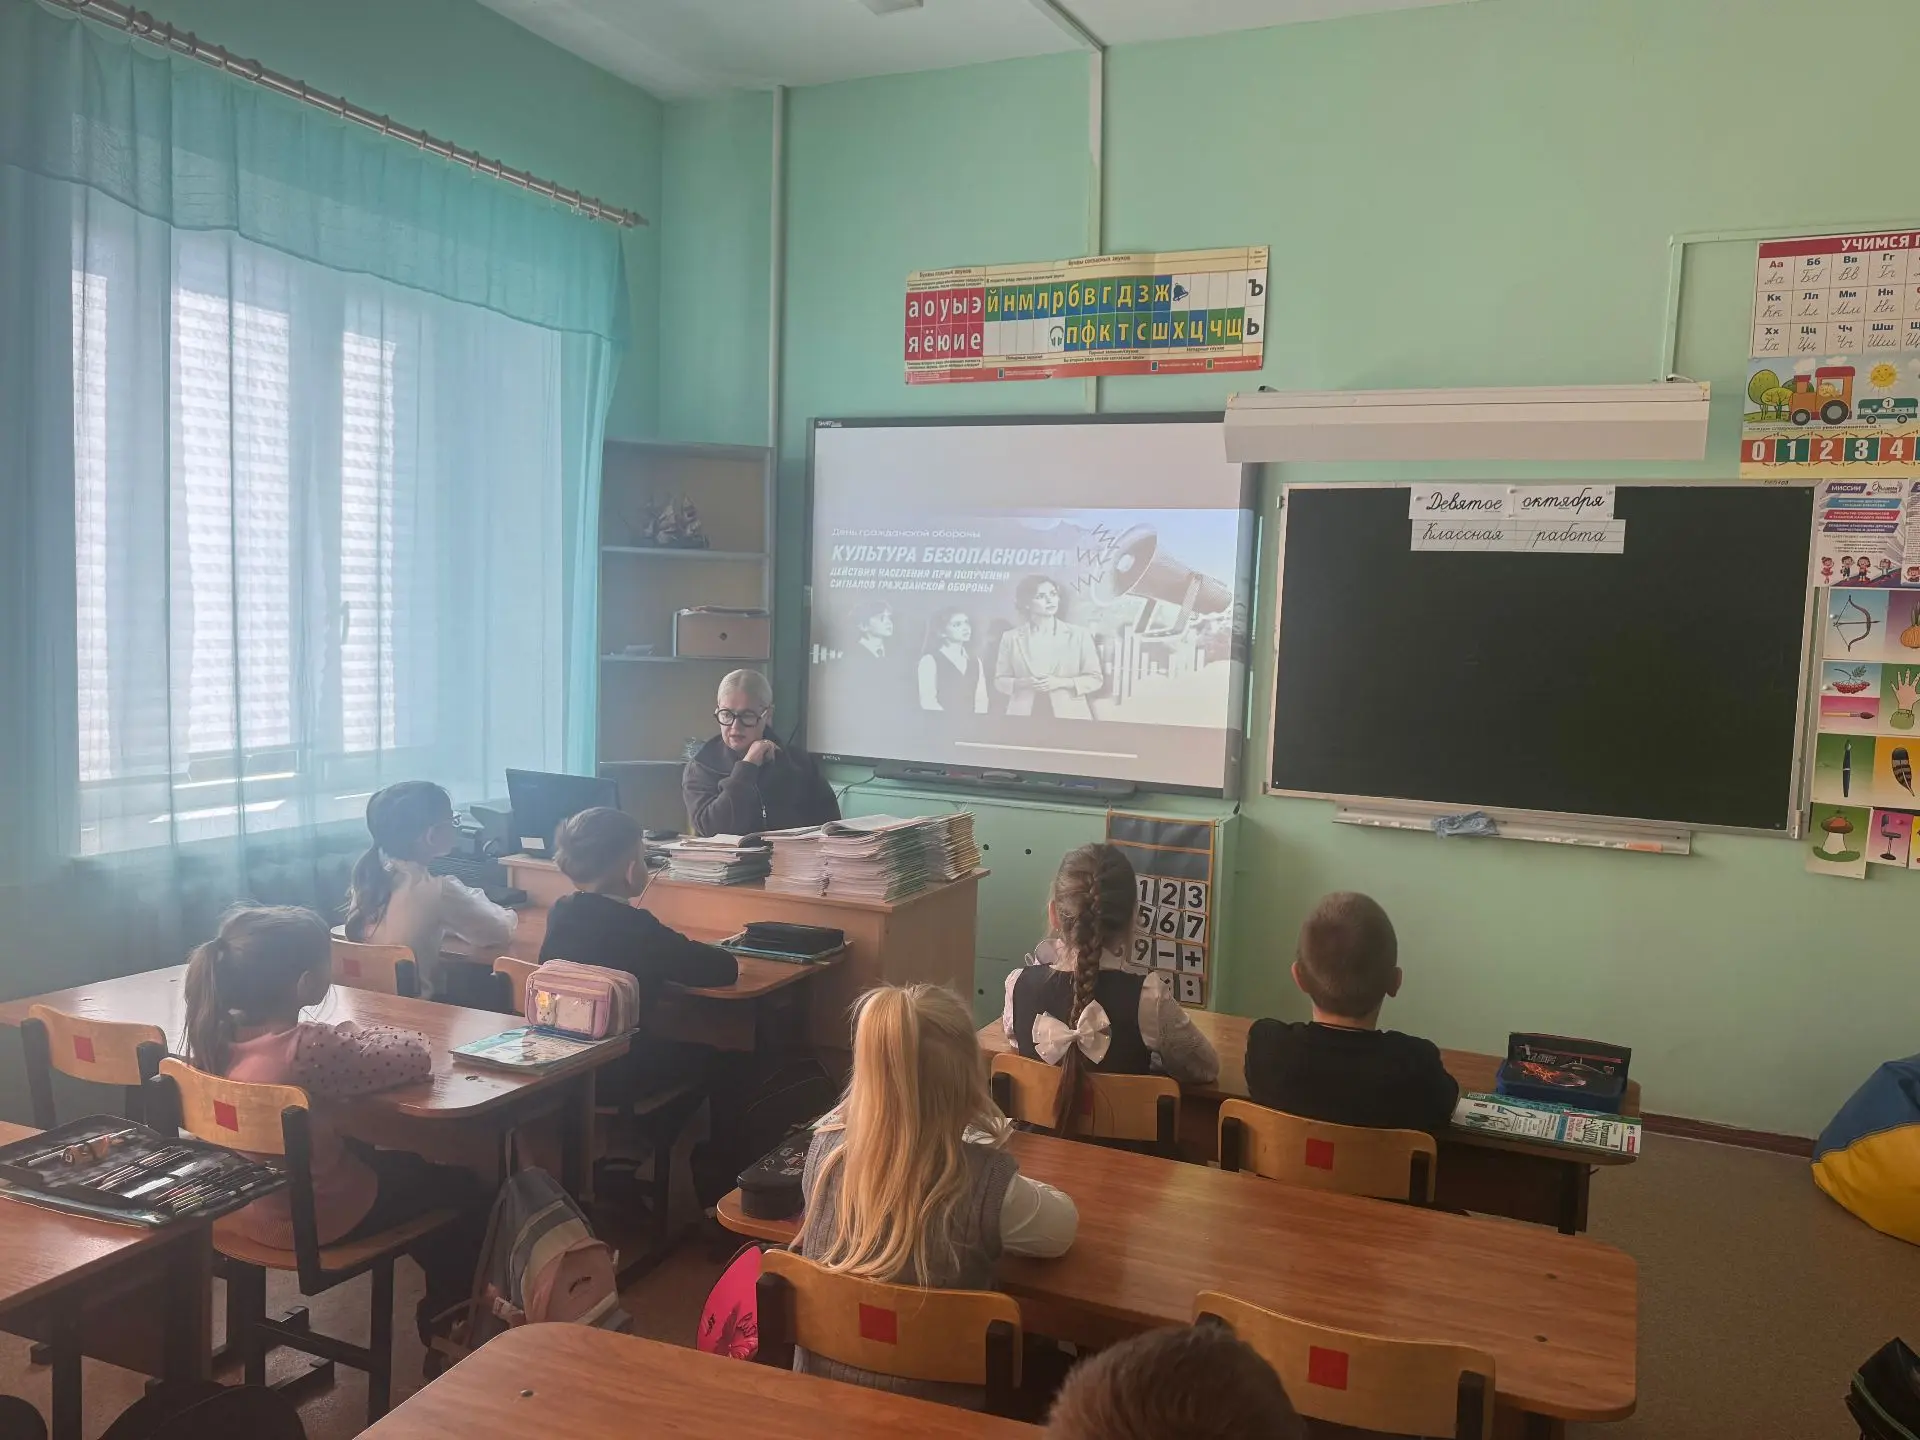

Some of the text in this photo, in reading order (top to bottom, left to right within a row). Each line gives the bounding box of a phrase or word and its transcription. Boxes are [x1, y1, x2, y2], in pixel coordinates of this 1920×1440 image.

[1841, 234, 1910, 251] УЧИМСЯ
[1769, 252, 1895, 269] Аа Бб Вв Гг
[1767, 288, 1894, 302] Кк Лл Мм Нн
[1765, 326, 1780, 335] Хх
[1801, 326, 1817, 336] Цц
[1838, 324, 1853, 333] Чч
[1872, 323, 1894, 331] Шш
[1752, 438, 1904, 461] 0 1 2 3 4
[1426, 488, 1605, 514] Девятое октября
[831, 528, 981, 538] День гражданской обороны
[1422, 522, 1606, 548] Классная работа
[831, 545, 1065, 566] КУЛЬТУРА БЕЗОПАСНОСТИ
[830, 567, 876, 578] ДЕЙСТВИЯ
[877, 568, 931, 579] НАСЕЛЕНИЯ
[932, 570, 951, 579] ПРИ
[829, 579, 994, 593] СИГНАЛОВ ГРАЖДАНСКОЙ ОБОРОНЫ
[1139, 879, 1203, 908] 1 2 3
[1137, 904, 1204, 938] 5 6 7
[1134, 938, 1150, 961] 9
